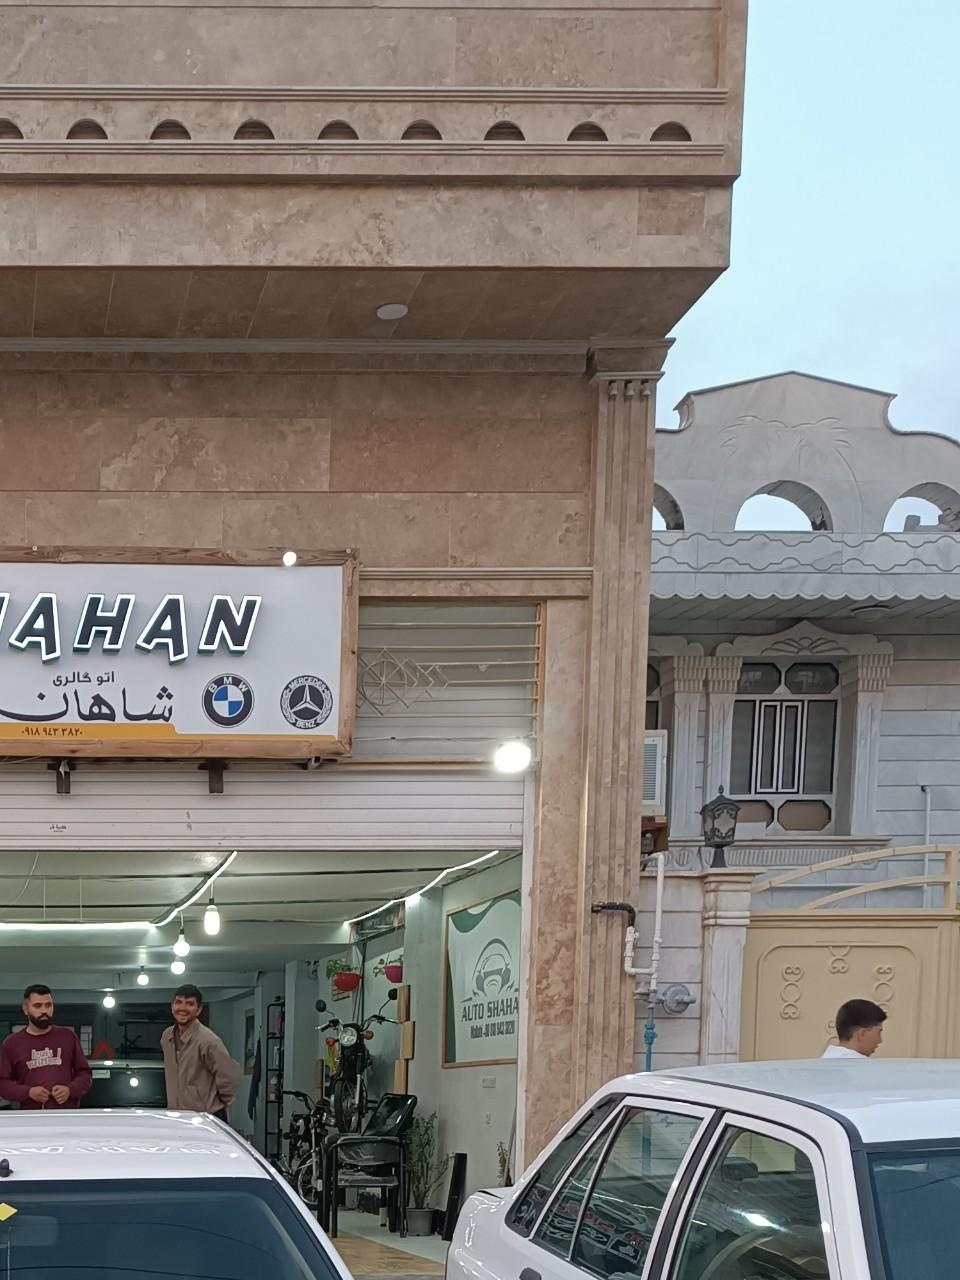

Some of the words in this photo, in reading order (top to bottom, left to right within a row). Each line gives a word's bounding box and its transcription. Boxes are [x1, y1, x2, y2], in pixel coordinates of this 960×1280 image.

[52, 671, 92, 687] گالری
[96, 671, 115, 686] اتو
[208, 676, 249, 693] BMW
[288, 676, 326, 691] MERCEDES
[295, 720, 316, 729] BENZ
[461, 1003, 484, 1022] AUTO
[487, 997, 519, 1018] SHAHA
